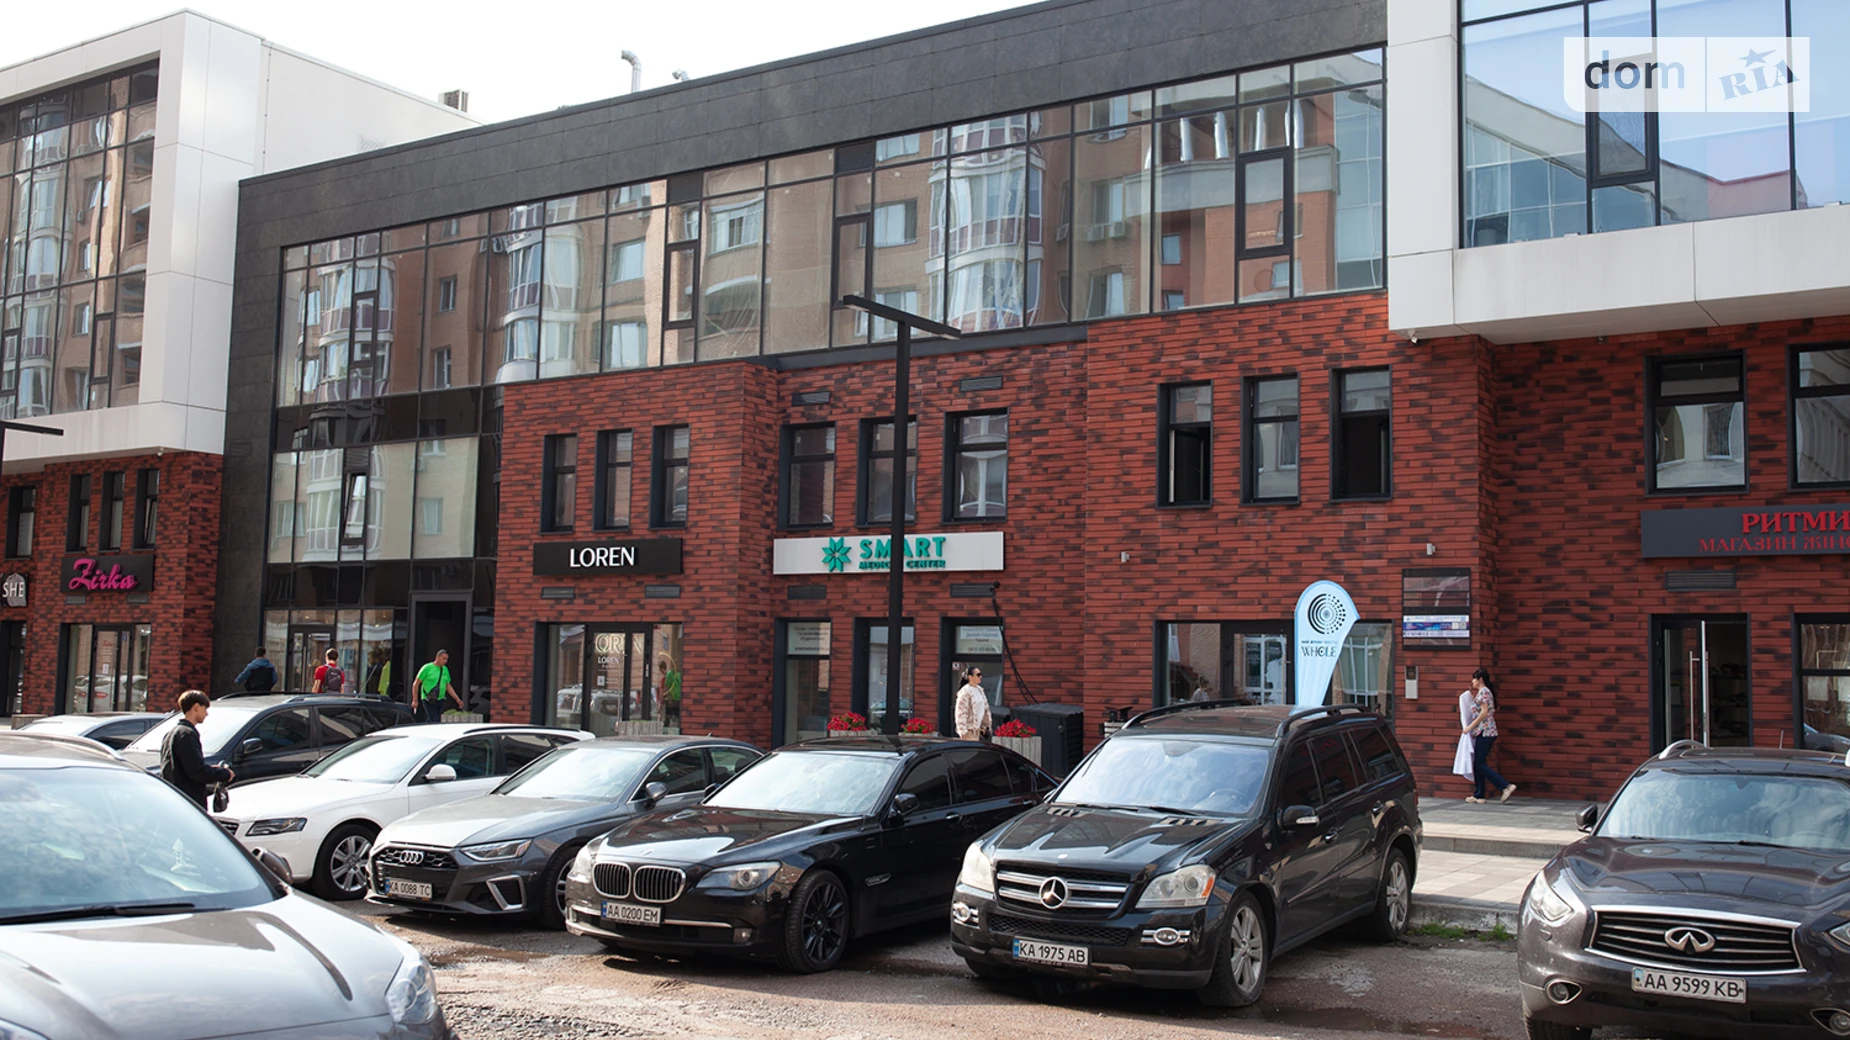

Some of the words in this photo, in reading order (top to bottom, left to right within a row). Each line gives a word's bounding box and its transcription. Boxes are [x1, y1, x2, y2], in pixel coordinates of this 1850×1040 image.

[859, 537, 947, 559] SMART
[1698, 536, 1797, 552] МАГАЗИН
[569, 546, 635, 568] LOREN
[905, 560, 946, 569] CENTER
[68, 558, 136, 590] Zirka
[2, 582, 25, 598] SHE
[1300, 645, 1337, 657] WHOLE
[390, 881, 399, 893] KA
[420, 885, 430, 896] TC
[607, 905, 620, 917] AA
[621, 906, 642, 920] 0200
[643, 909, 659, 922] EM
[1019, 942, 1036, 957] KA
[1038, 945, 1065, 961] 1975
[1067, 949, 1086, 963] AB
[1644, 973, 1667, 990] AA
[1672, 976, 1710, 995] 9599
[1714, 981, 1739, 998] KB
